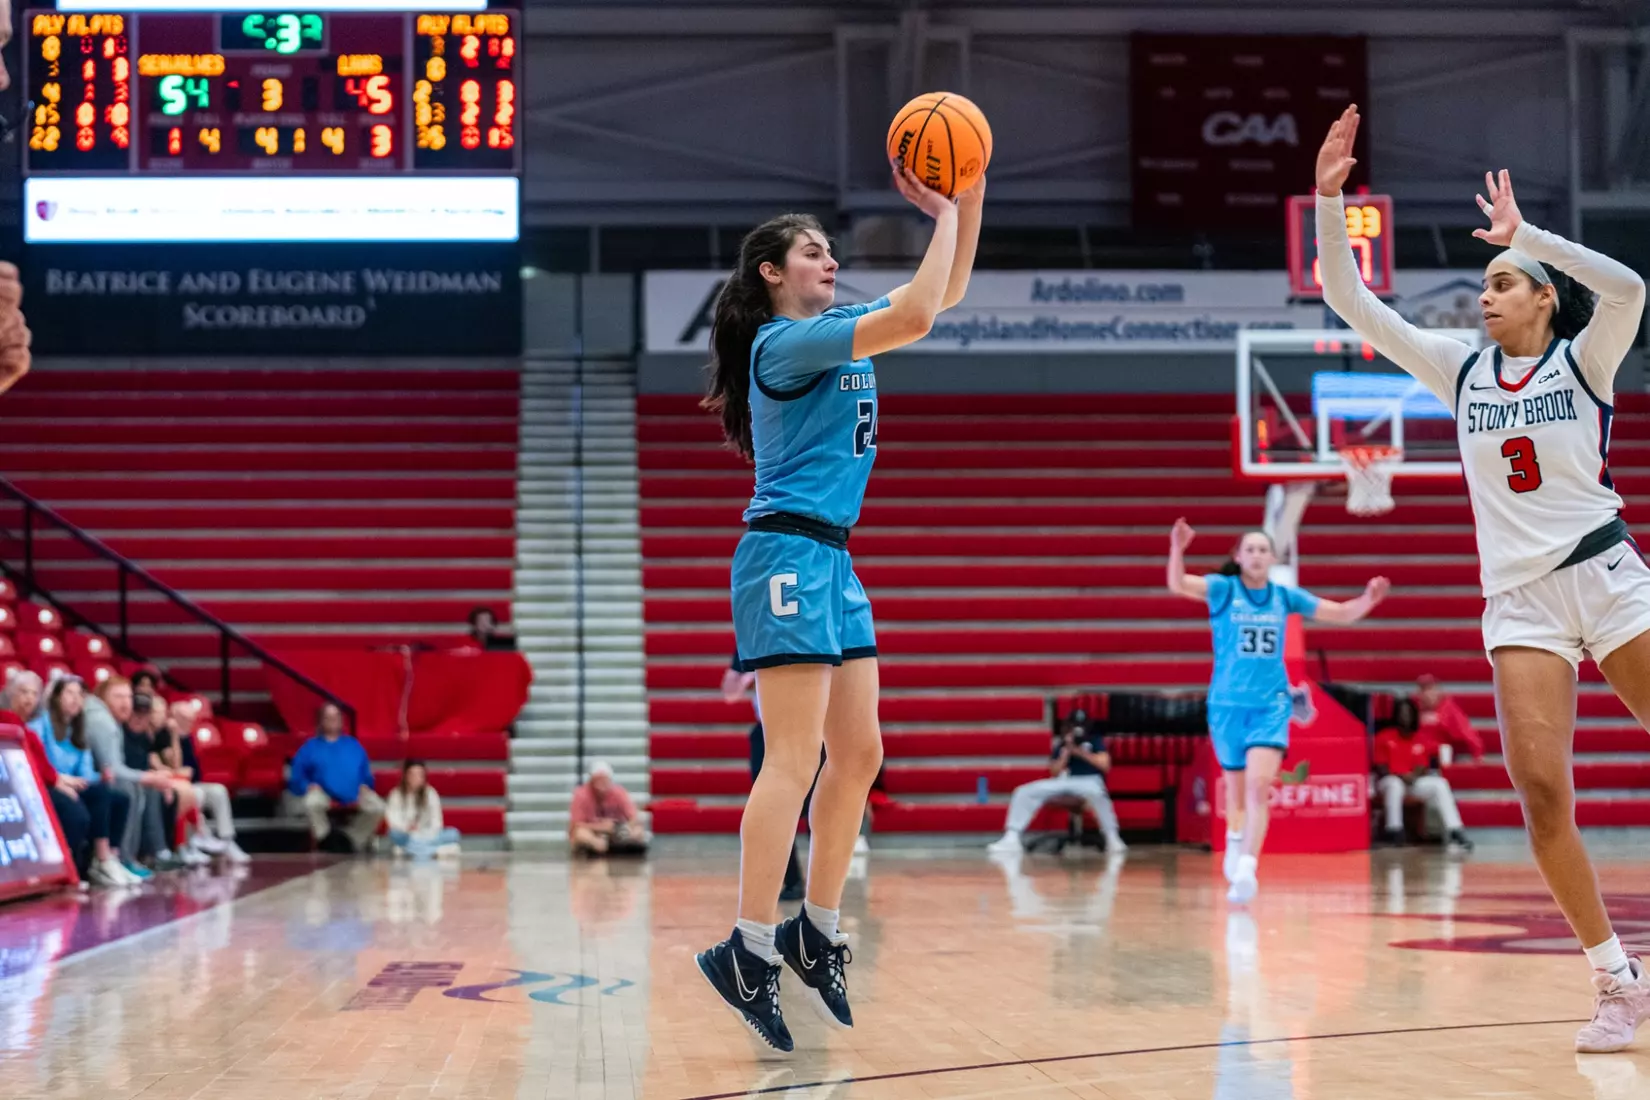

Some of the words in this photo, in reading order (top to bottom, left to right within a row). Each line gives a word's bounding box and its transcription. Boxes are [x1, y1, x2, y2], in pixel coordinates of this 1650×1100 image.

[159, 75, 209, 115] 54
[262, 78, 283, 112] 3
[345, 75, 392, 114] 45
[199, 128, 221, 153] 4
[321, 127, 345, 155] 4
[369, 124, 392, 158] 3
[1203, 112, 1298, 146] CAA
[840, 373, 876, 392] COLU
[1537, 369, 1562, 385] CAA
[1468, 401, 1519, 434] STONY
[1523, 388, 1578, 426] BROOK
[1501, 436, 1543, 494] 3
[769, 572, 799, 618] C
[1239, 626, 1279, 656] 35
[1267, 783, 1356, 809] DEFINE
